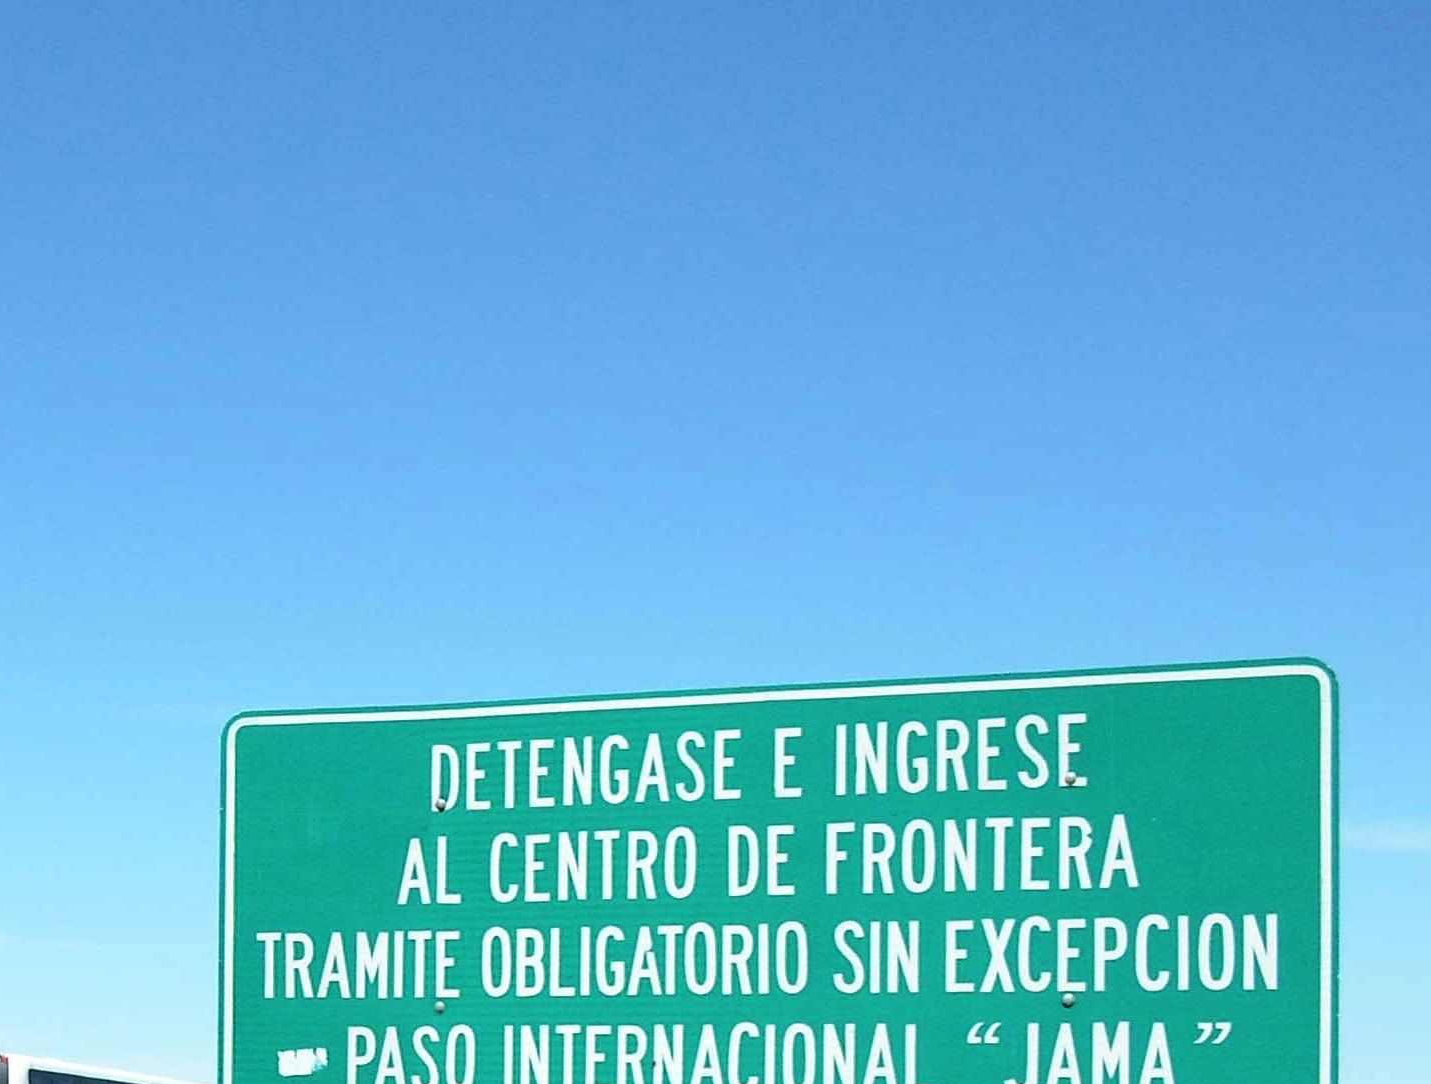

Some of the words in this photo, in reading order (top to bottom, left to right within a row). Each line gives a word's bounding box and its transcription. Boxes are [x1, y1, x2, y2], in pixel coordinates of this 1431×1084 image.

[431, 730, 741, 812] DETENGASE
[774, 728, 802, 798] E
[835, 714, 1087, 796] INGRESE
[397, 837, 462, 905] AL
[490, 827, 697, 903] CENTRO
[728, 825, 795, 897] DE
[826, 815, 1139, 894] FRONTERA
[256, 931, 460, 999] TRAMITE
[481, 921, 808, 997] OBLIGATORIO
[833, 921, 920, 994] SIN
[945, 914, 1278, 993] EXCEPCION
